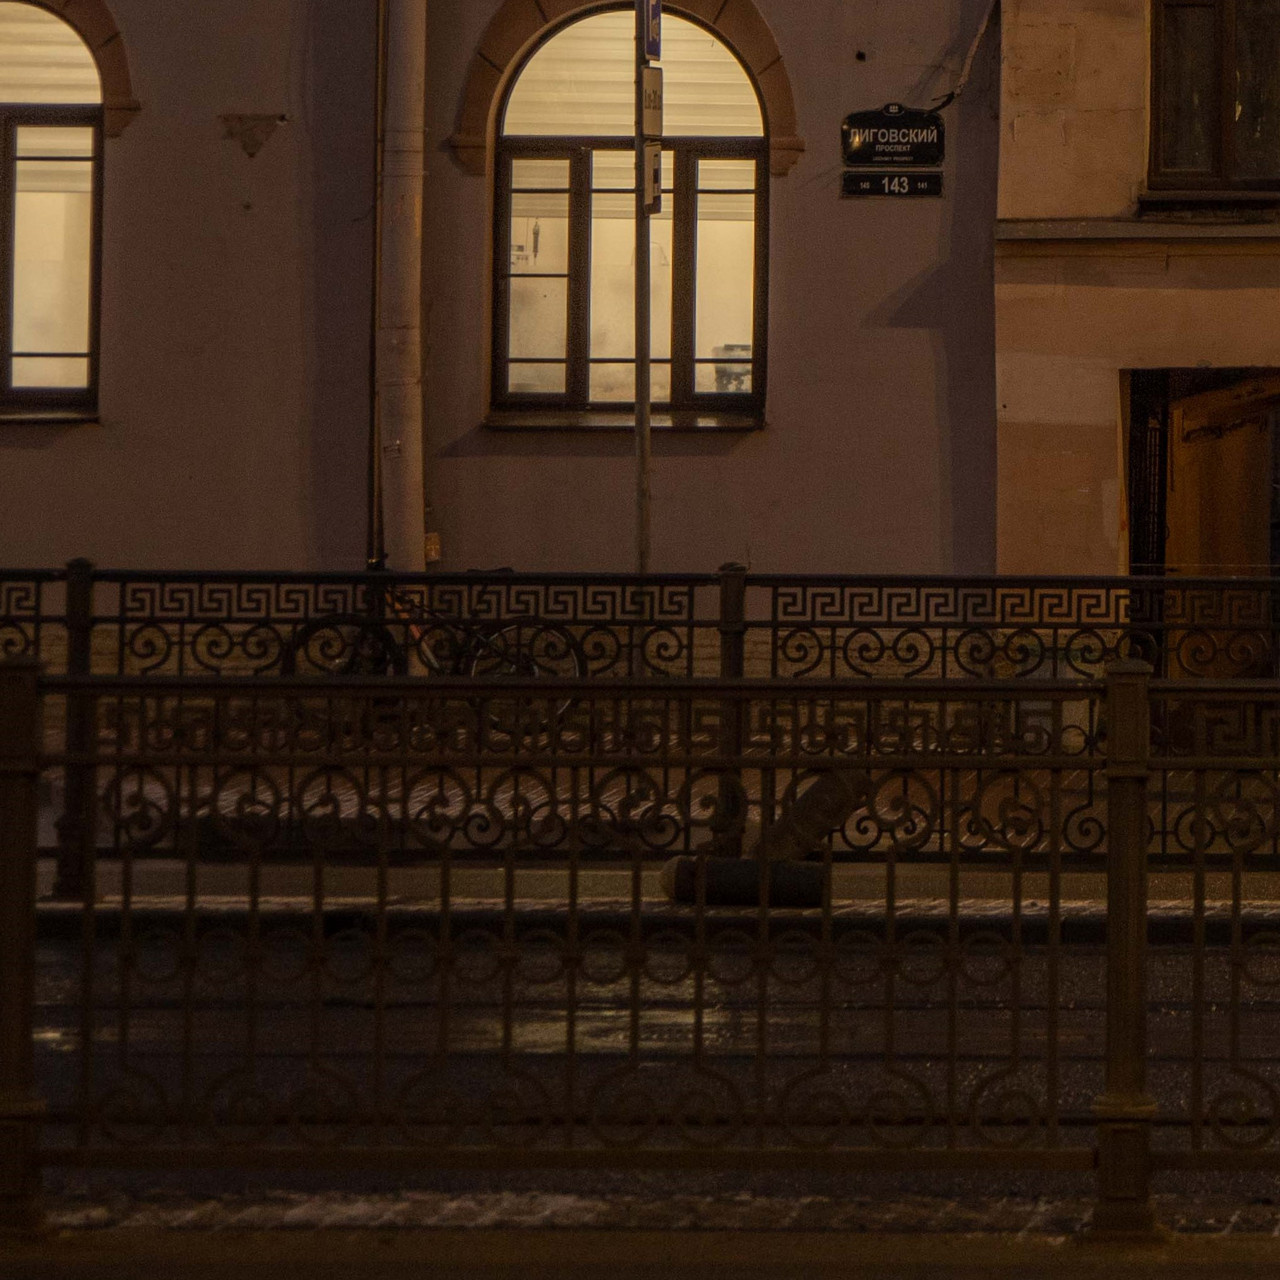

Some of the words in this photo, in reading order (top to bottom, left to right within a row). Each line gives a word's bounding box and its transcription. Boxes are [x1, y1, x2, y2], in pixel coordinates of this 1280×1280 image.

[849, 126, 938, 143] ЛИГОВСКИЙ
[875, 144, 911, 152] ПРОСПЕКТ
[881, 176, 909, 193] 143
